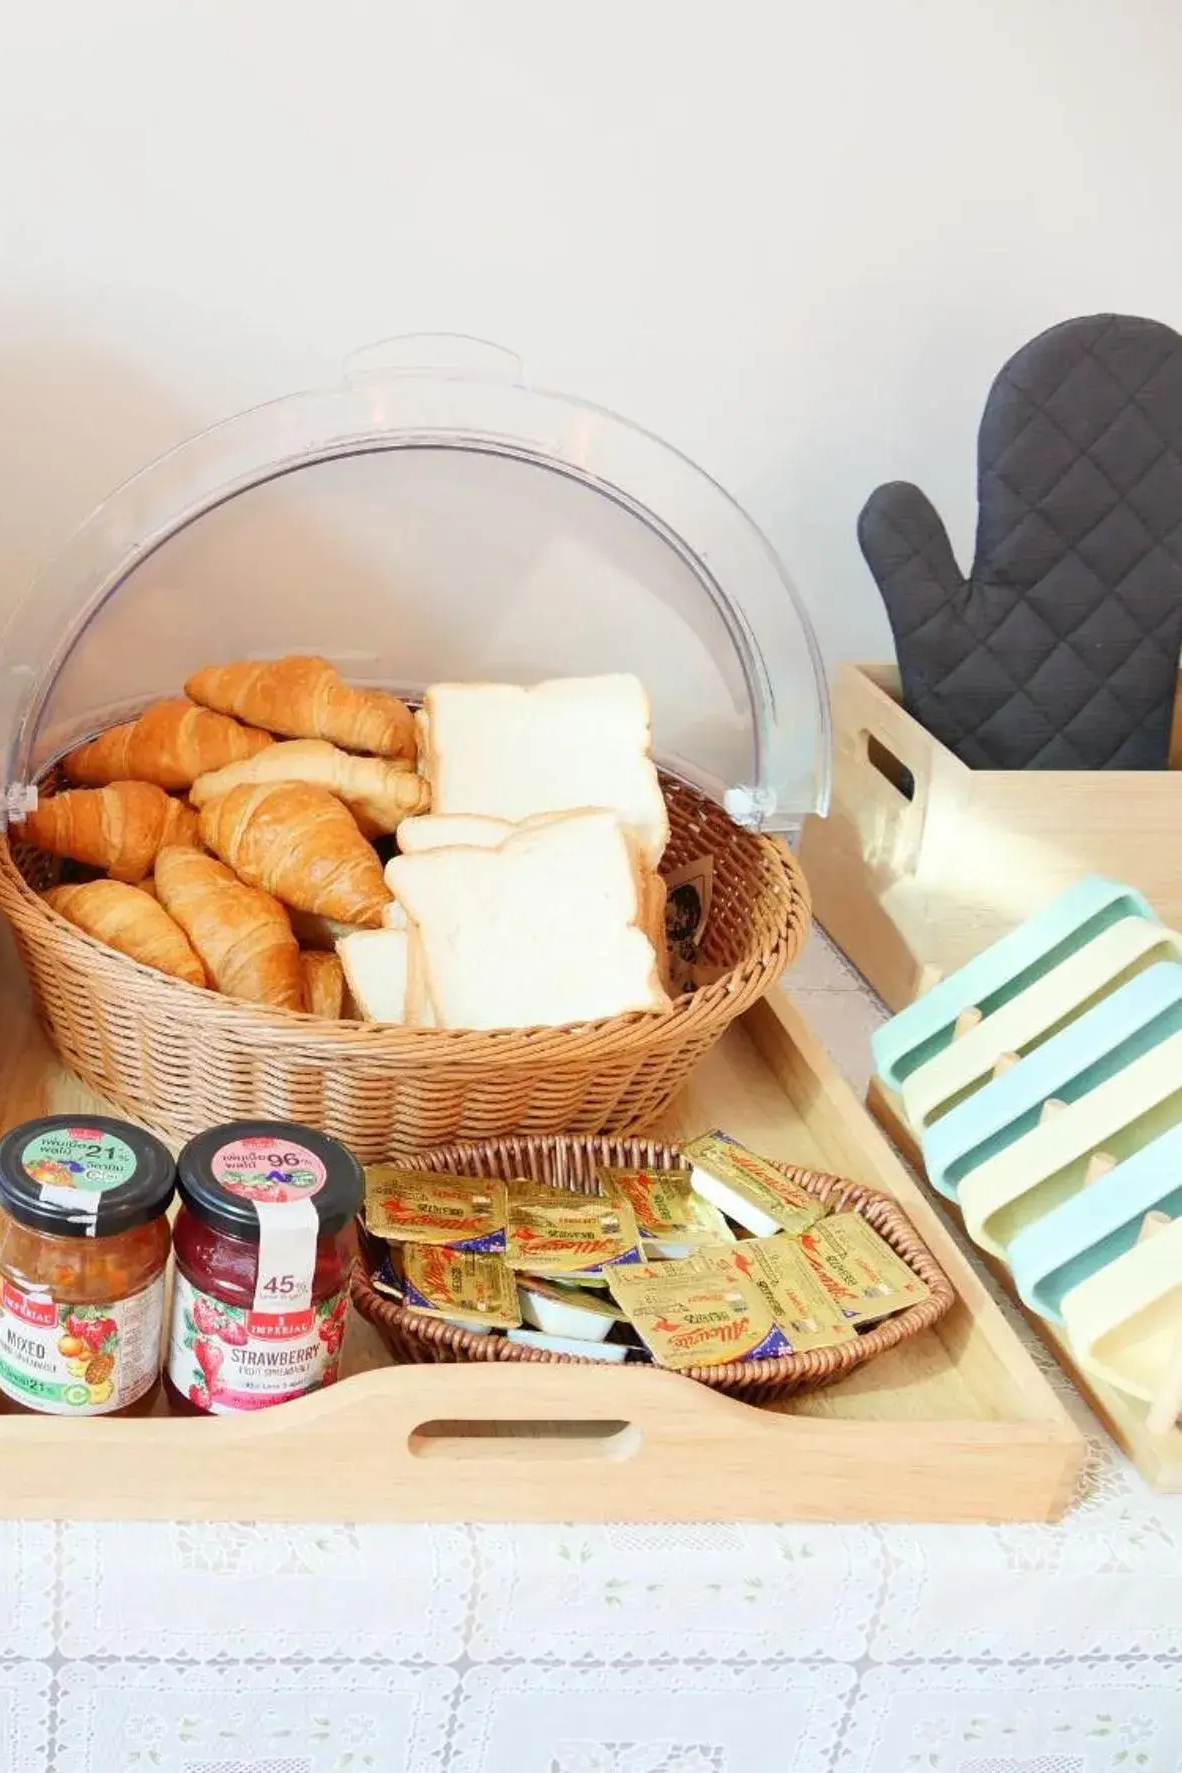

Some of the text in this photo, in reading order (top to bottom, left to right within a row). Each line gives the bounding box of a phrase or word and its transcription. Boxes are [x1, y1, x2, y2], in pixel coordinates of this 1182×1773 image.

[250, 1322, 308, 1335] IMPERIAL
[6, 1328, 46, 1359] MIXED
[230, 1342, 321, 1366] STRAWBERRY
